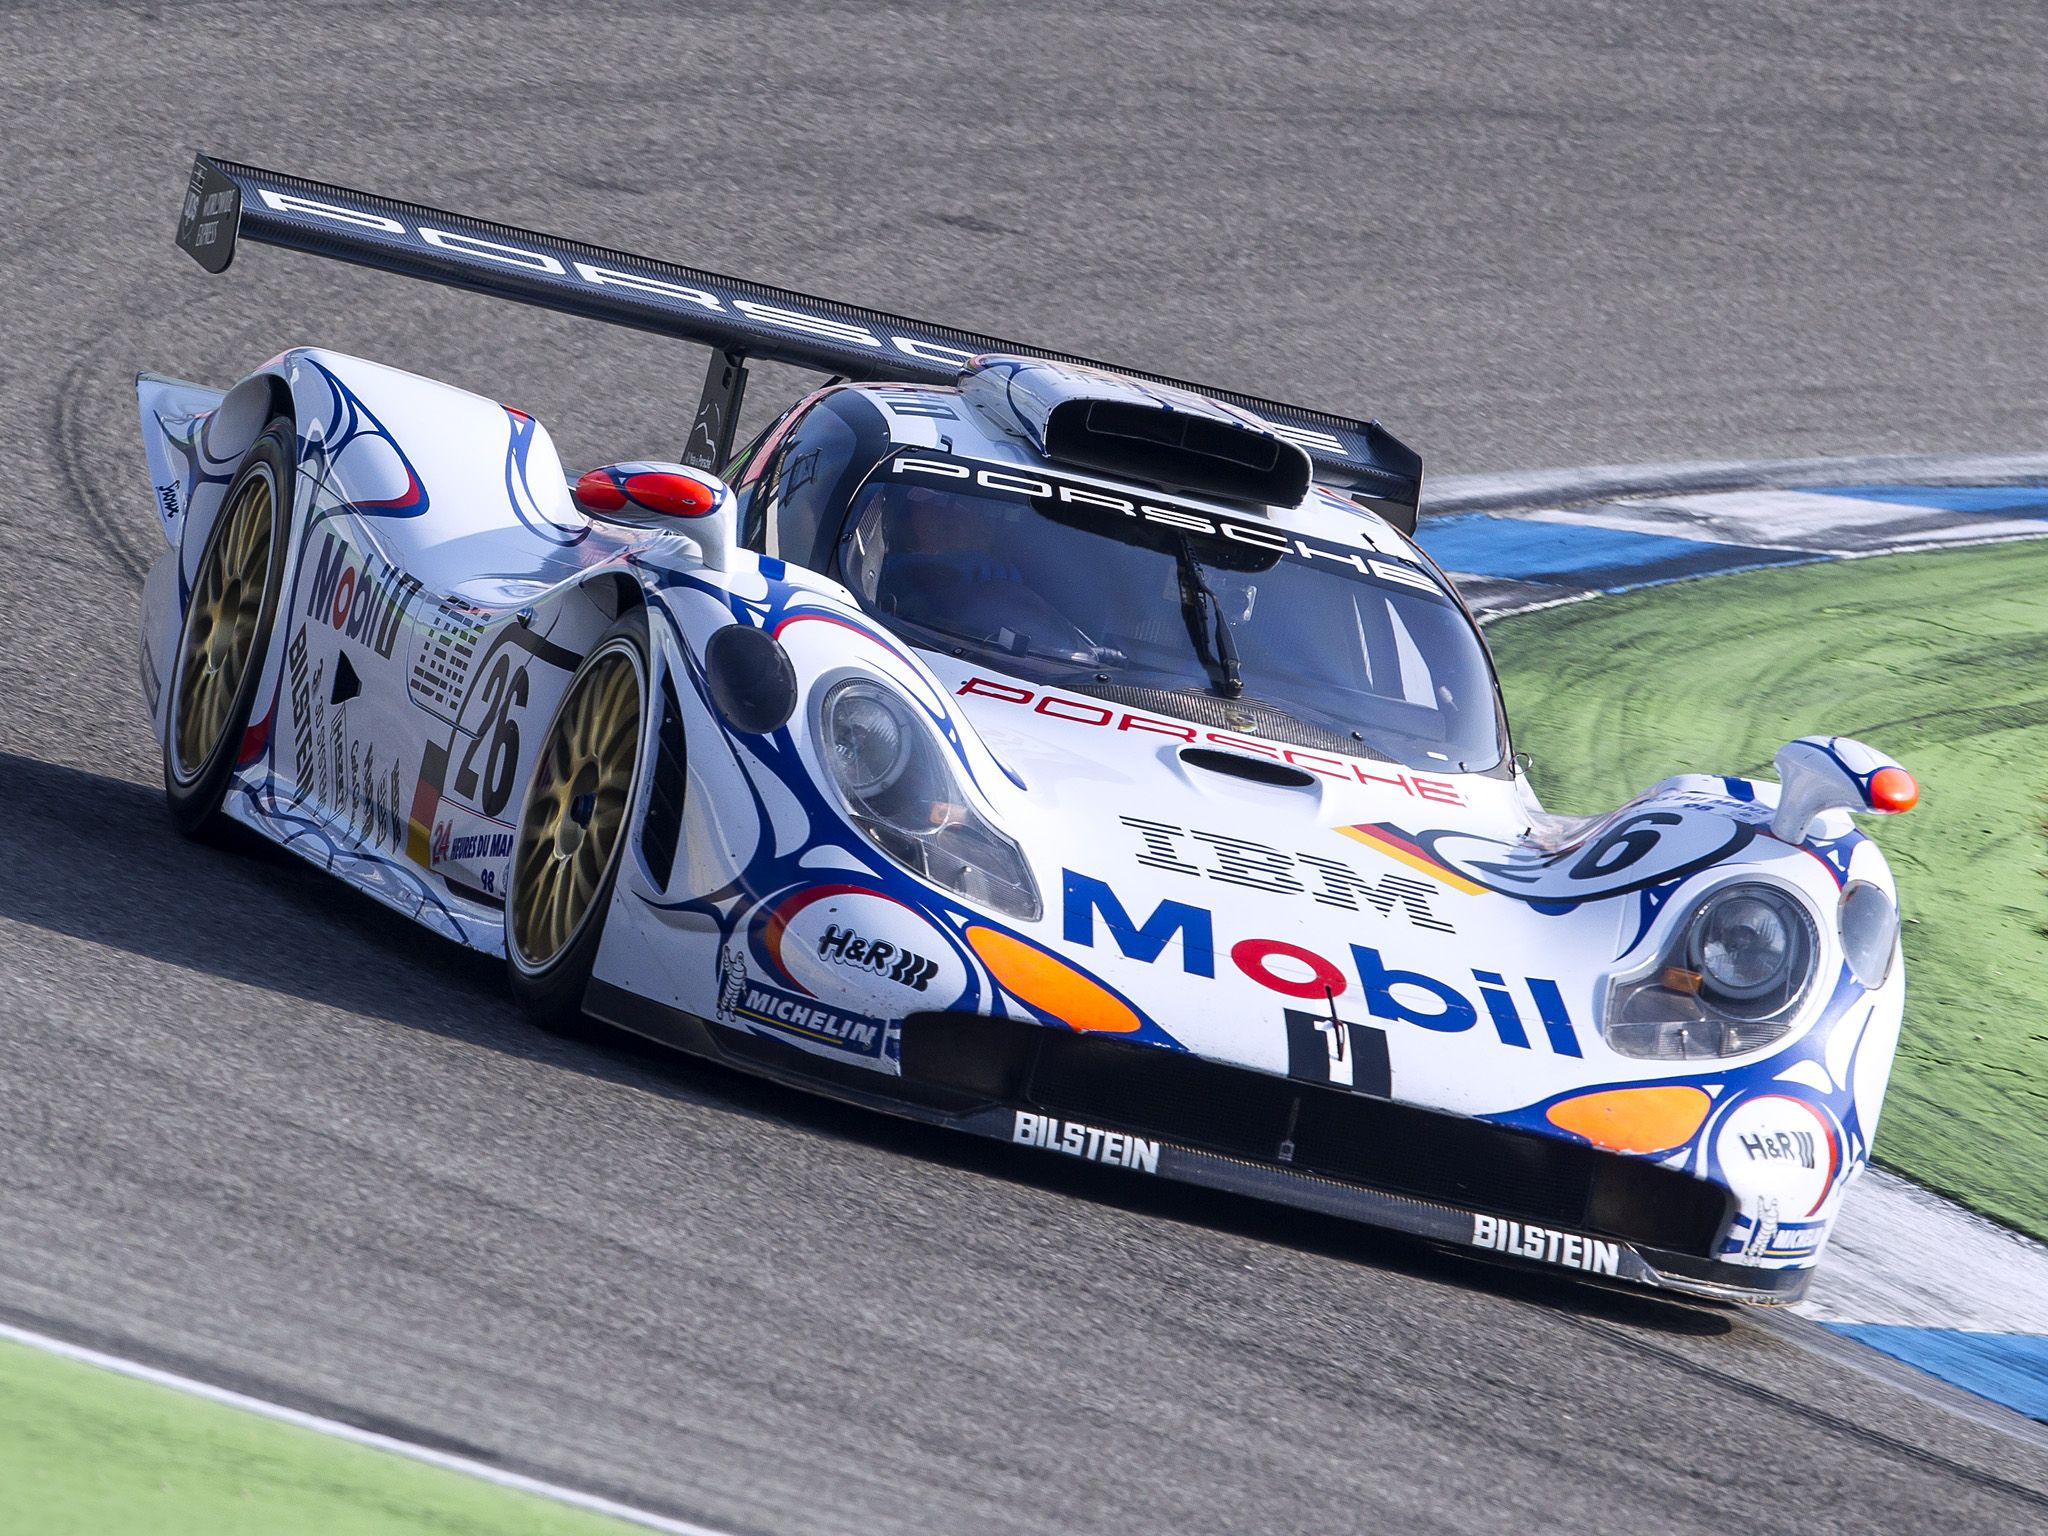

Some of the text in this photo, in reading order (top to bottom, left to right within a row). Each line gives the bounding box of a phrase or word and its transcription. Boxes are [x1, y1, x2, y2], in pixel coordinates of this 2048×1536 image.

[258, 188, 1349, 456] PORSCE
[892, 457, 1445, 597] PORSCHE
[306, 532, 400, 649] Mobil
[410, 595, 492, 711] IBM
[286, 621, 315, 813] BILSTEIN
[453, 652, 530, 817] 26
[956, 677, 1468, 808] PORSCHE
[432, 820, 515, 867] 24 HEURES DU MAN
[481, 868, 496, 893] 98
[1118, 814, 1456, 935] IBM
[817, 923, 898, 977] H&R
[1061, 867, 1584, 1059] Mobil
[744, 990, 880, 1045] MICHELIN
[1012, 1110, 1160, 1174] BILSTEIN
[1739, 1131, 1796, 1161] H&R
[1471, 1215, 1620, 1277] BILSTEIN
